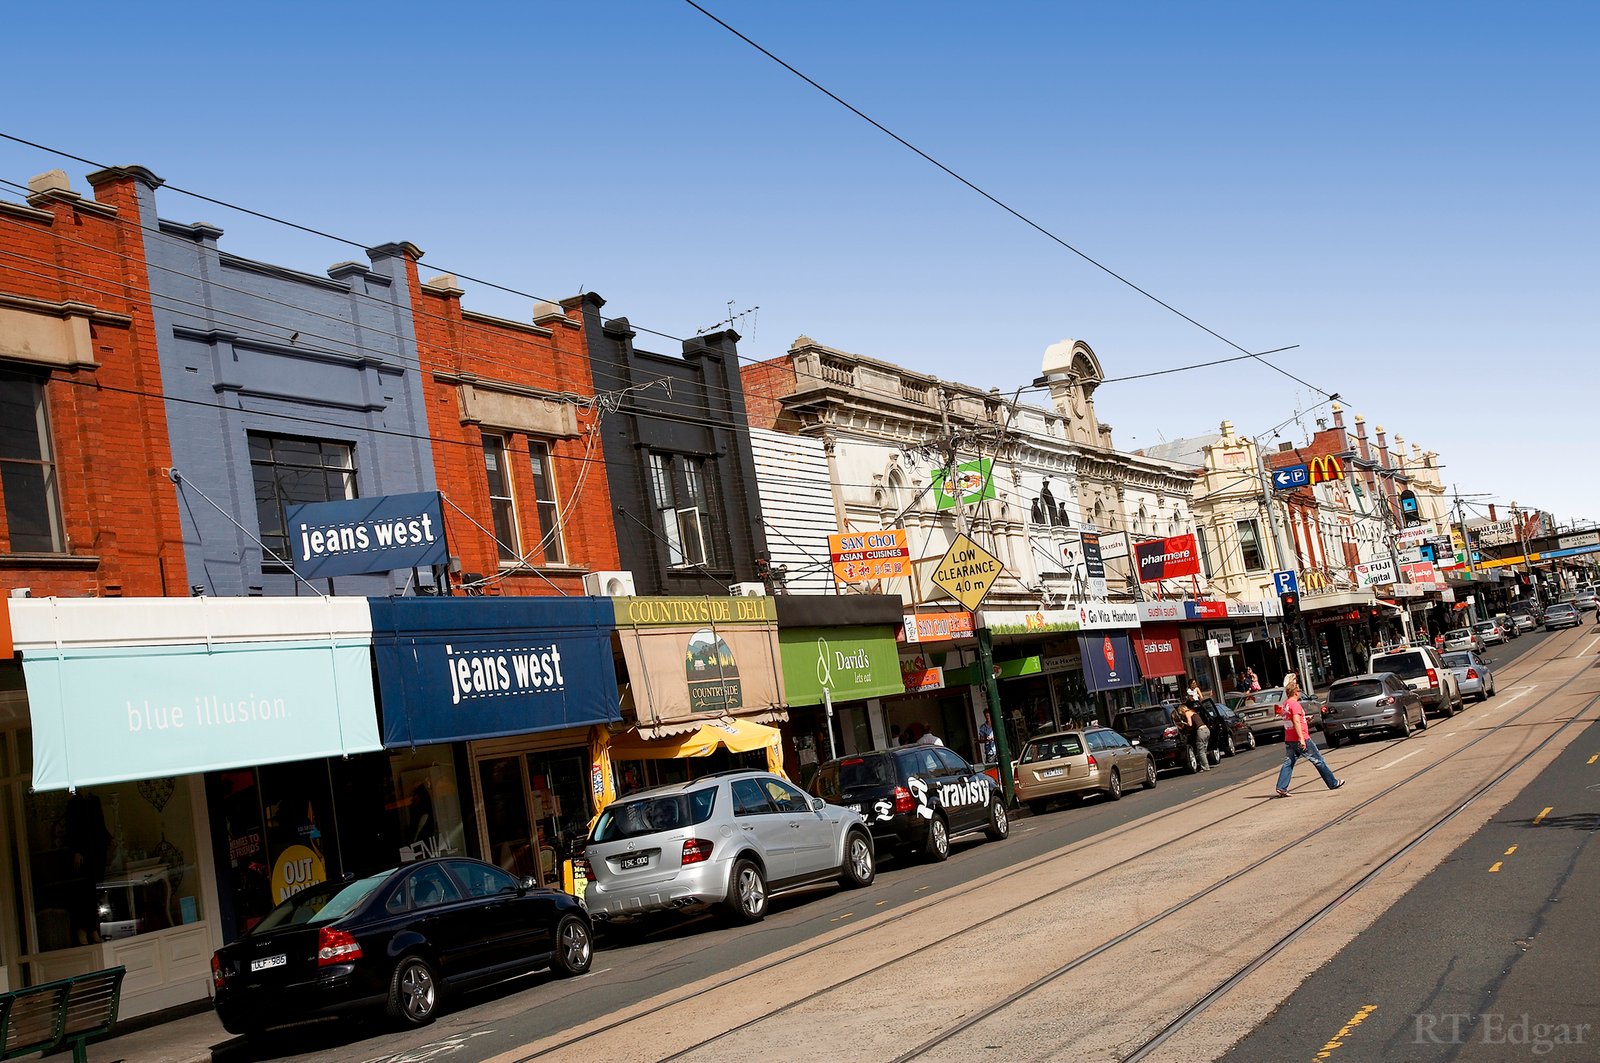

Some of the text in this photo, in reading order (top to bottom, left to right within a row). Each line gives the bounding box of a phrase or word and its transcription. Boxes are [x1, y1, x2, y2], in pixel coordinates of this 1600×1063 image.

[301, 513, 434, 561] jeans west
[841, 536, 864, 551] SAN
[839, 549, 902, 562] ASIAN CUISINES
[953, 549, 976, 564] LOW
[937, 561, 995, 581] CLEARANCE
[1370, 562, 1390, 571] FUJI
[955, 579, 985, 593] 4.0 m
[1364, 573, 1390, 584] digital
[629, 600, 766, 622] COUNTRYSIDE DELI
[1089, 608, 1137, 623] Go Vita Hawthorn
[1148, 605, 1178, 617] sushi sushi
[918, 619, 933, 637] SAN
[1144, 641, 1172, 653] sushi sushi
[835, 648, 870, 670] David's
[446, 644, 564, 704] jeans west
[127, 693, 286, 732] blue illusion
[283, 857, 313, 885] OUT
